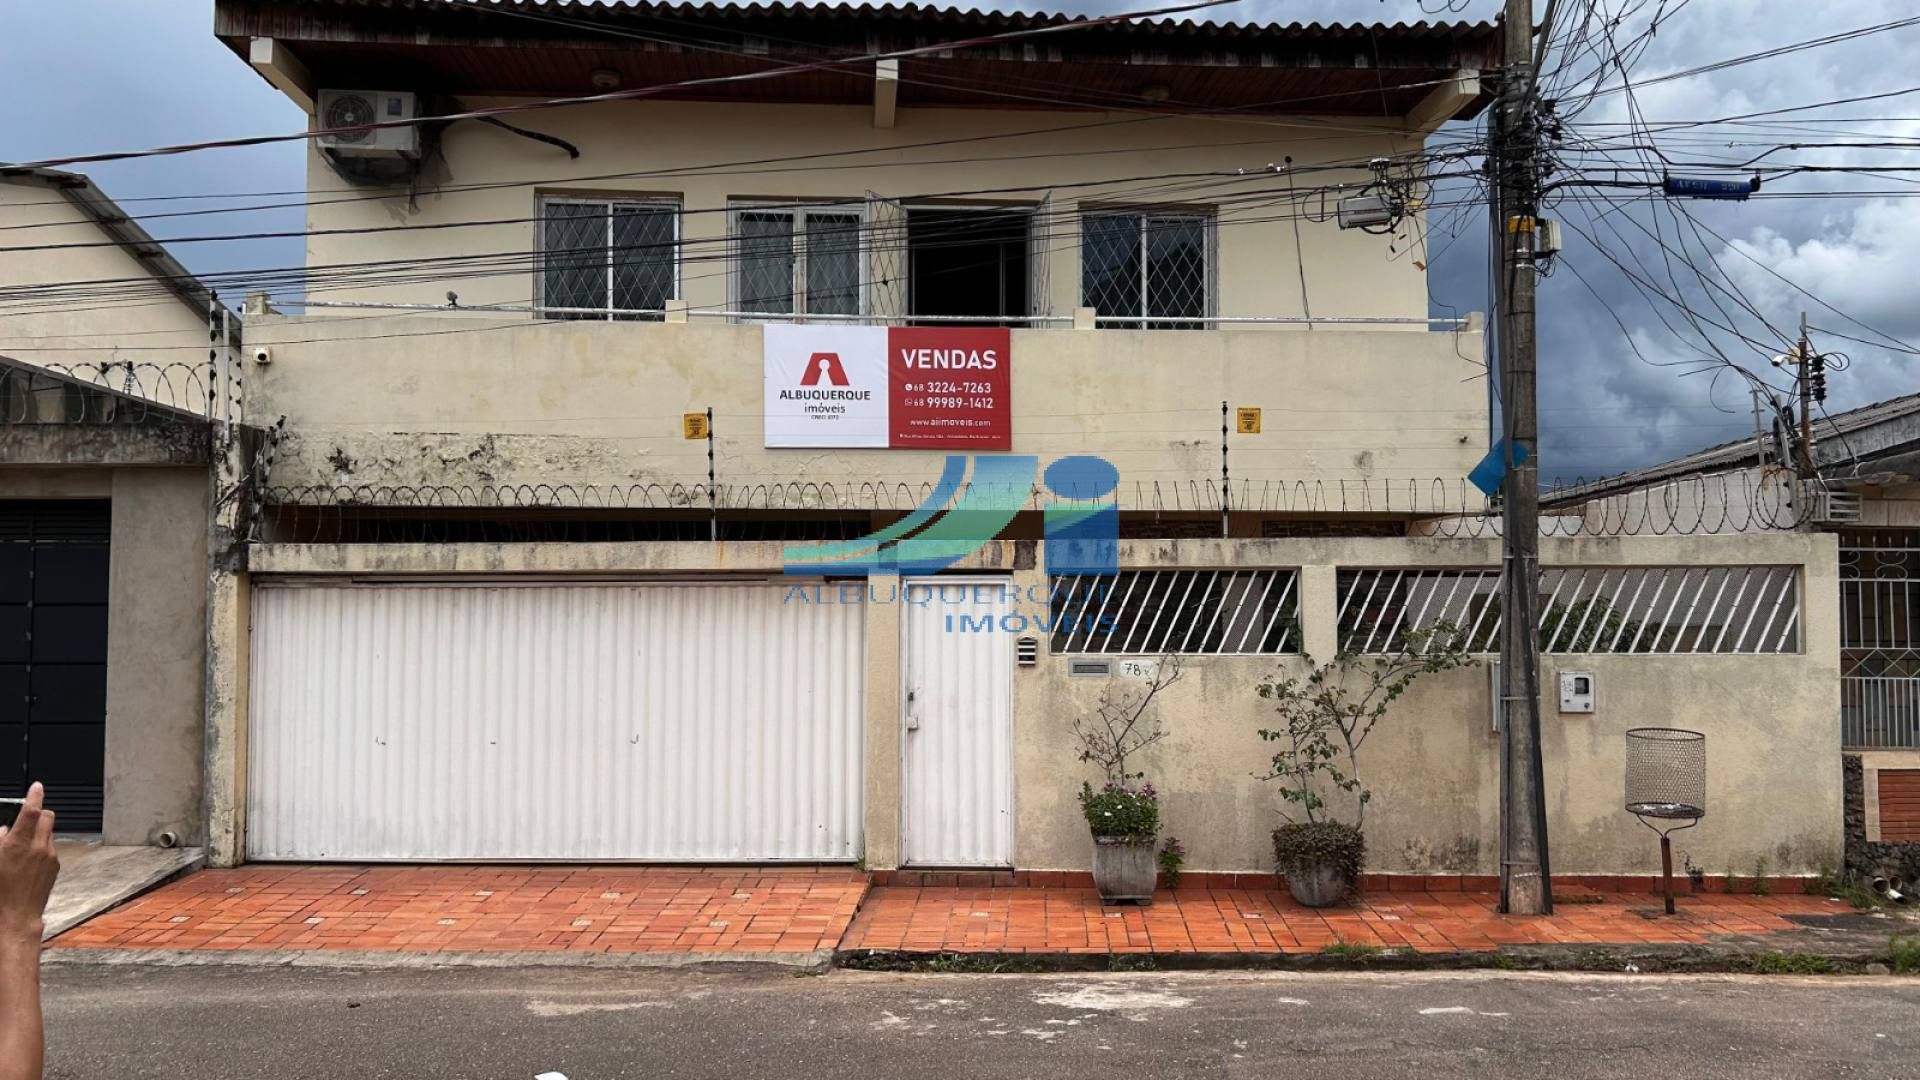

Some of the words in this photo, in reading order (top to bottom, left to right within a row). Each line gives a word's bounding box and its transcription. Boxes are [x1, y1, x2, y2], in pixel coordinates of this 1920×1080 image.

[901, 349, 997, 369] VENDAS
[913, 383, 925, 392] 68
[927, 382, 992, 393] 3224-7263
[779, 389, 871, 401] ALBUQUERQUE
[804, 401, 846, 414] imóveis
[927, 396, 994, 409] 99989-1412
